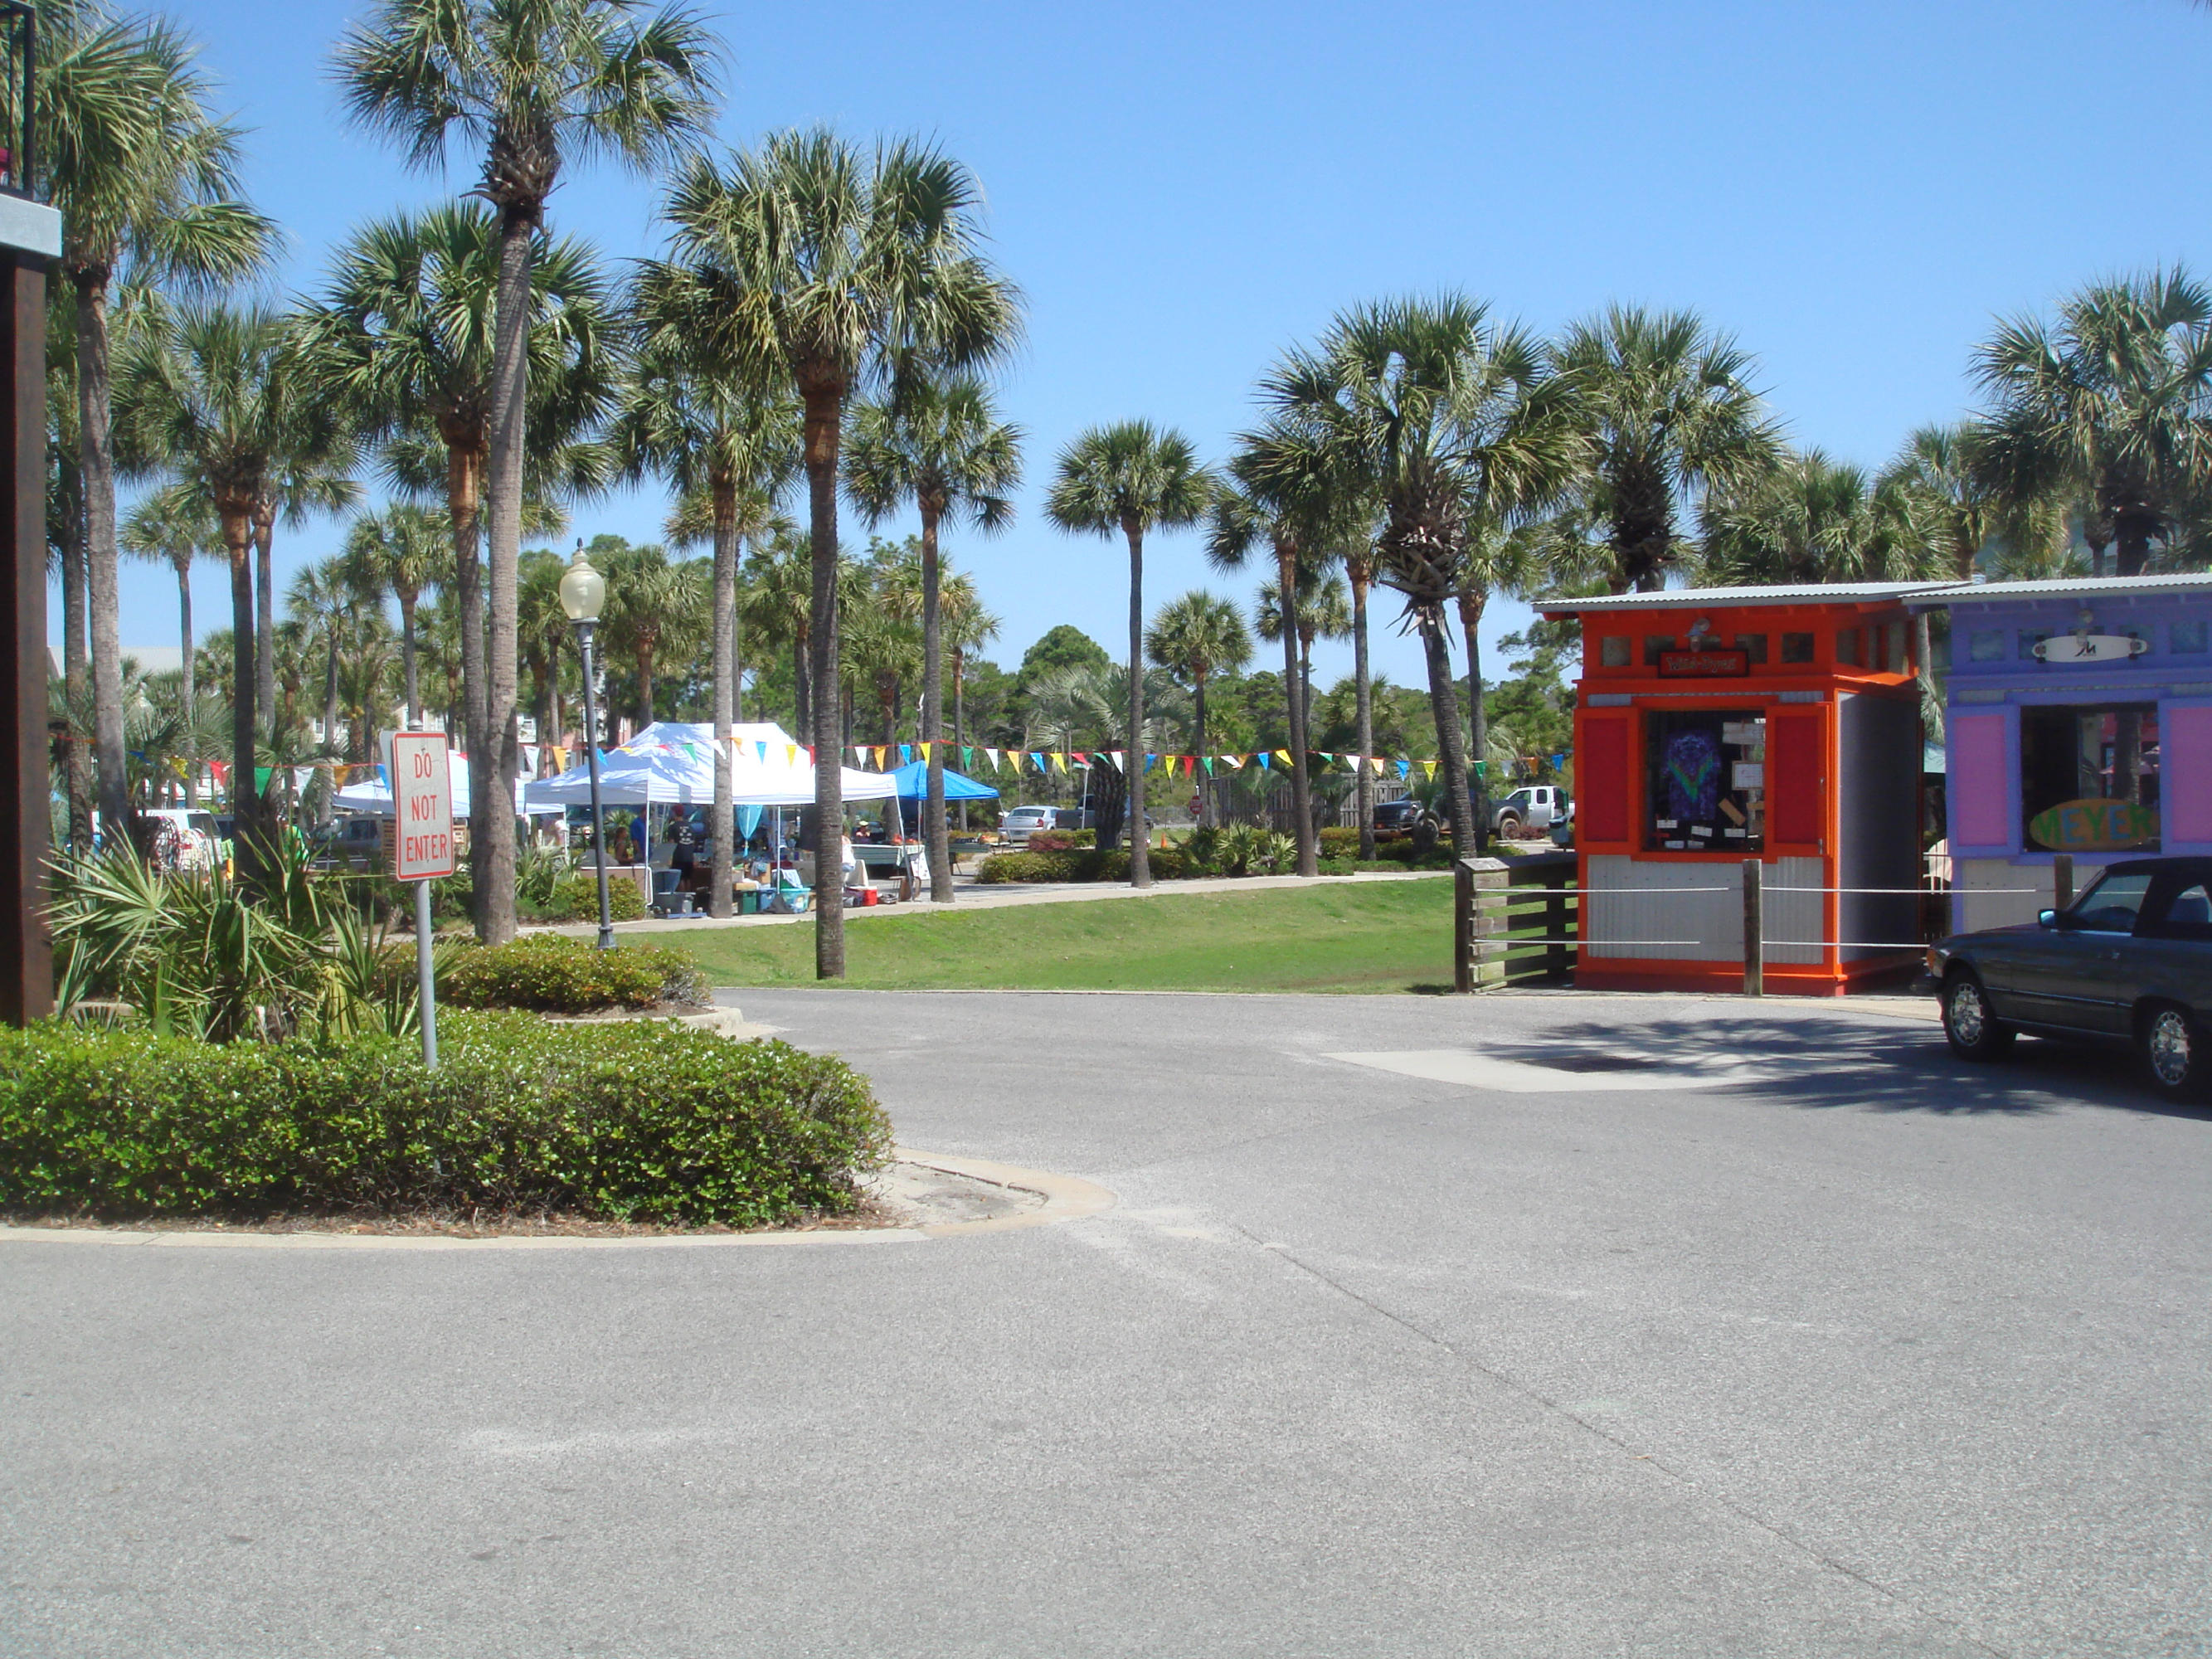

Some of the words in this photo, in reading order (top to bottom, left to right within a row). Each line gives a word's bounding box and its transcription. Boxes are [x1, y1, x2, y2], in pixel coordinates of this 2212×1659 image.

[414, 752, 432, 778] DO
[411, 795, 437, 821] NOT
[406, 834, 448, 862] ENTER
